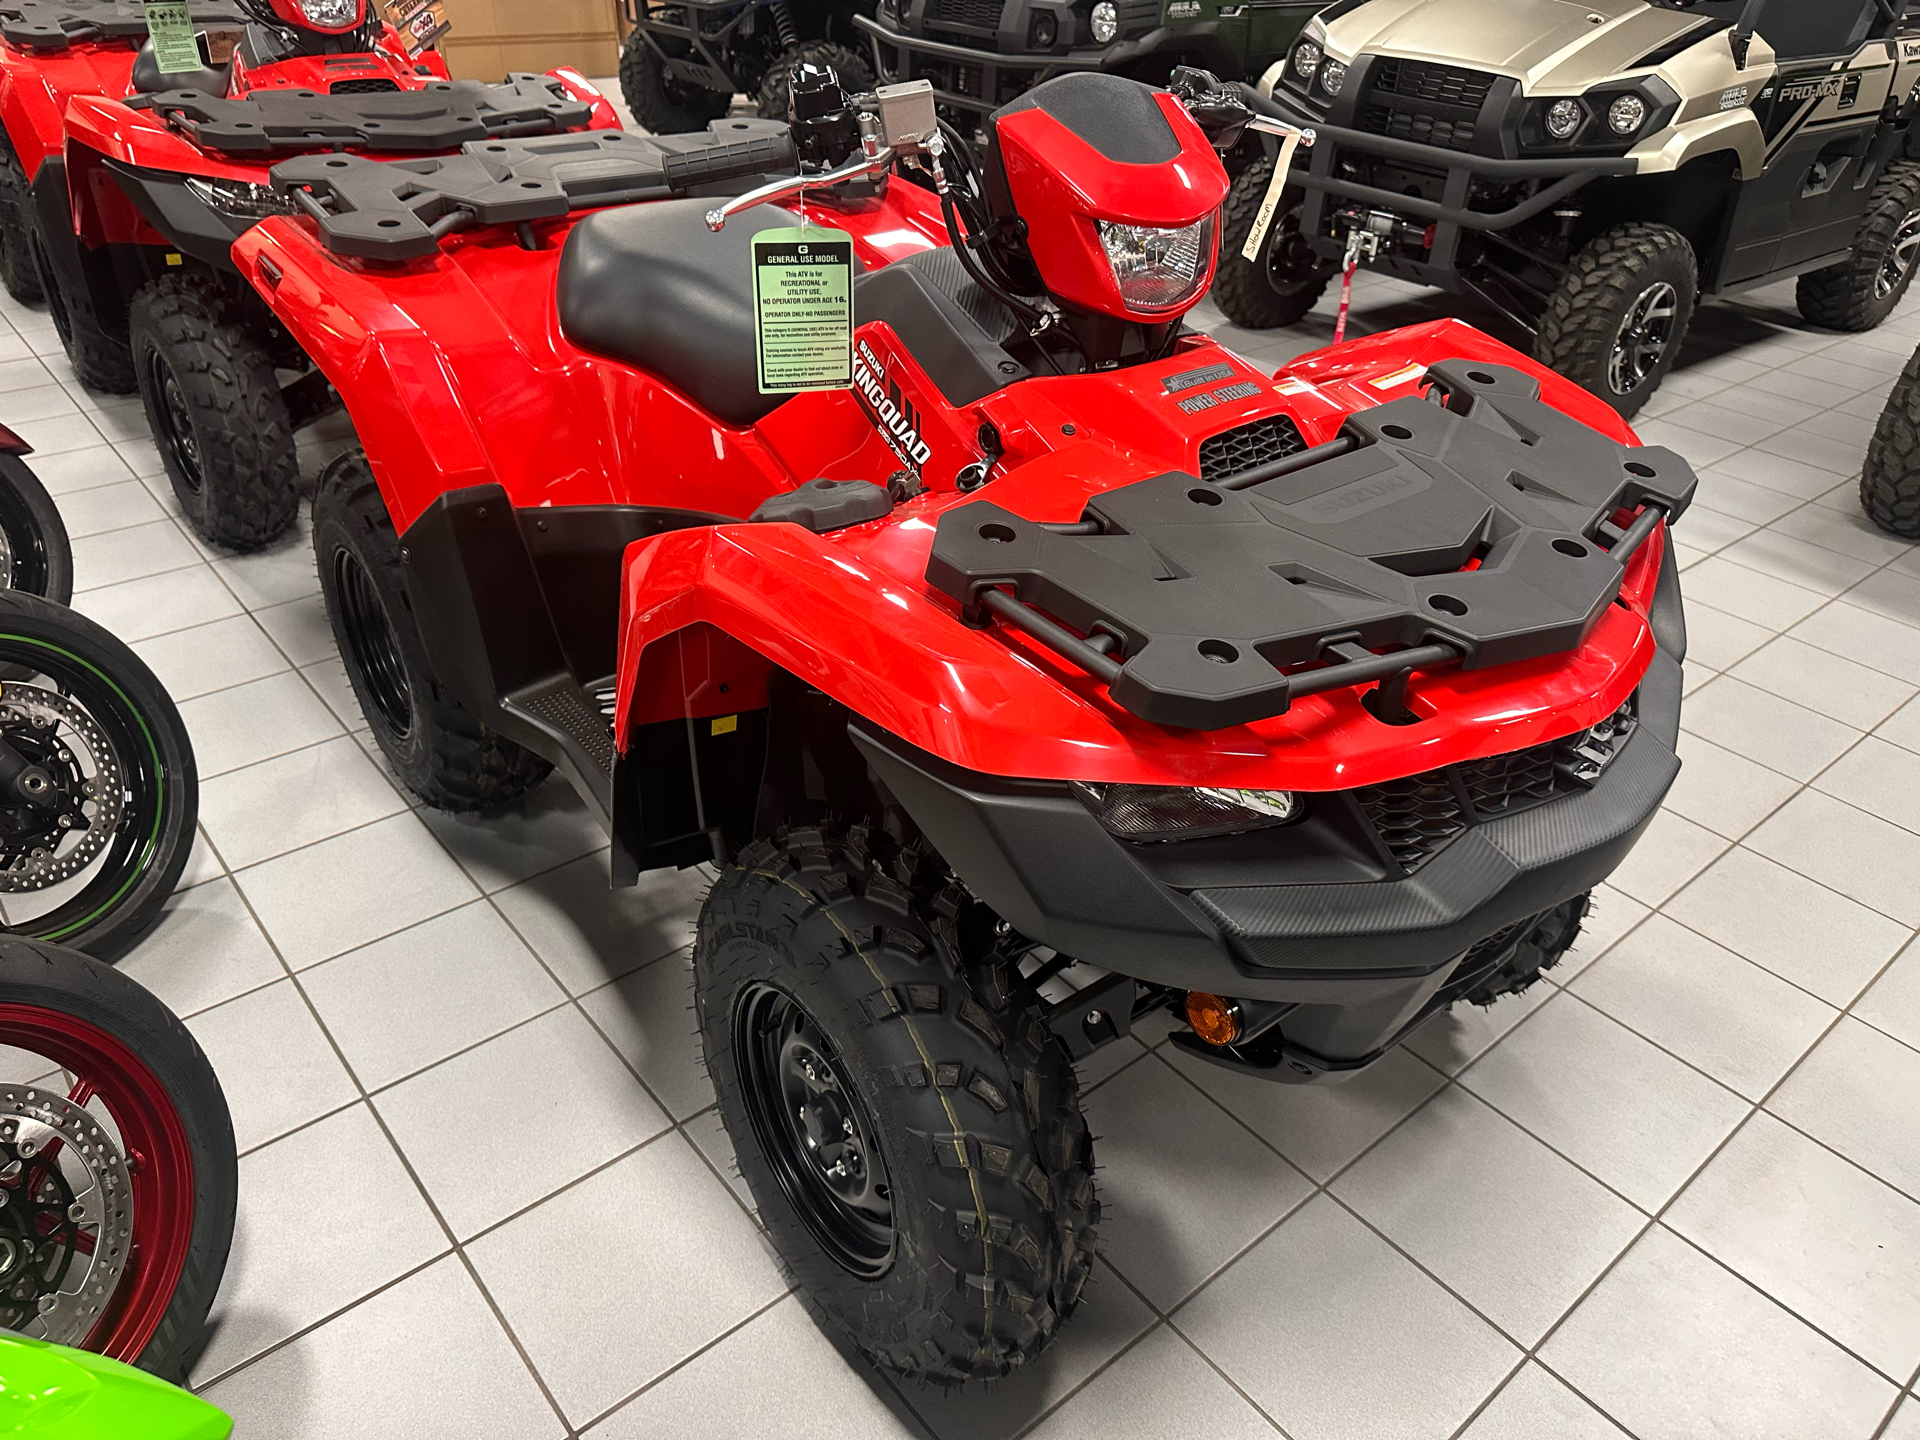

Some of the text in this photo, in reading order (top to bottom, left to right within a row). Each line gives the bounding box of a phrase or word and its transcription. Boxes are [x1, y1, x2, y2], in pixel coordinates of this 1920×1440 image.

[1778, 81, 1839, 102] PRO-MX
[1246, 203, 1273, 254] SHOWROOM
[768, 254, 839, 264] GENERAL USE MODEL
[798, 245, 808, 254] G
[858, 340, 884, 379] SUZUKI
[1184, 370, 1235, 388] Built in USA
[1176, 392, 1220, 416] POWER
[1212, 381, 1263, 403] STEERING
